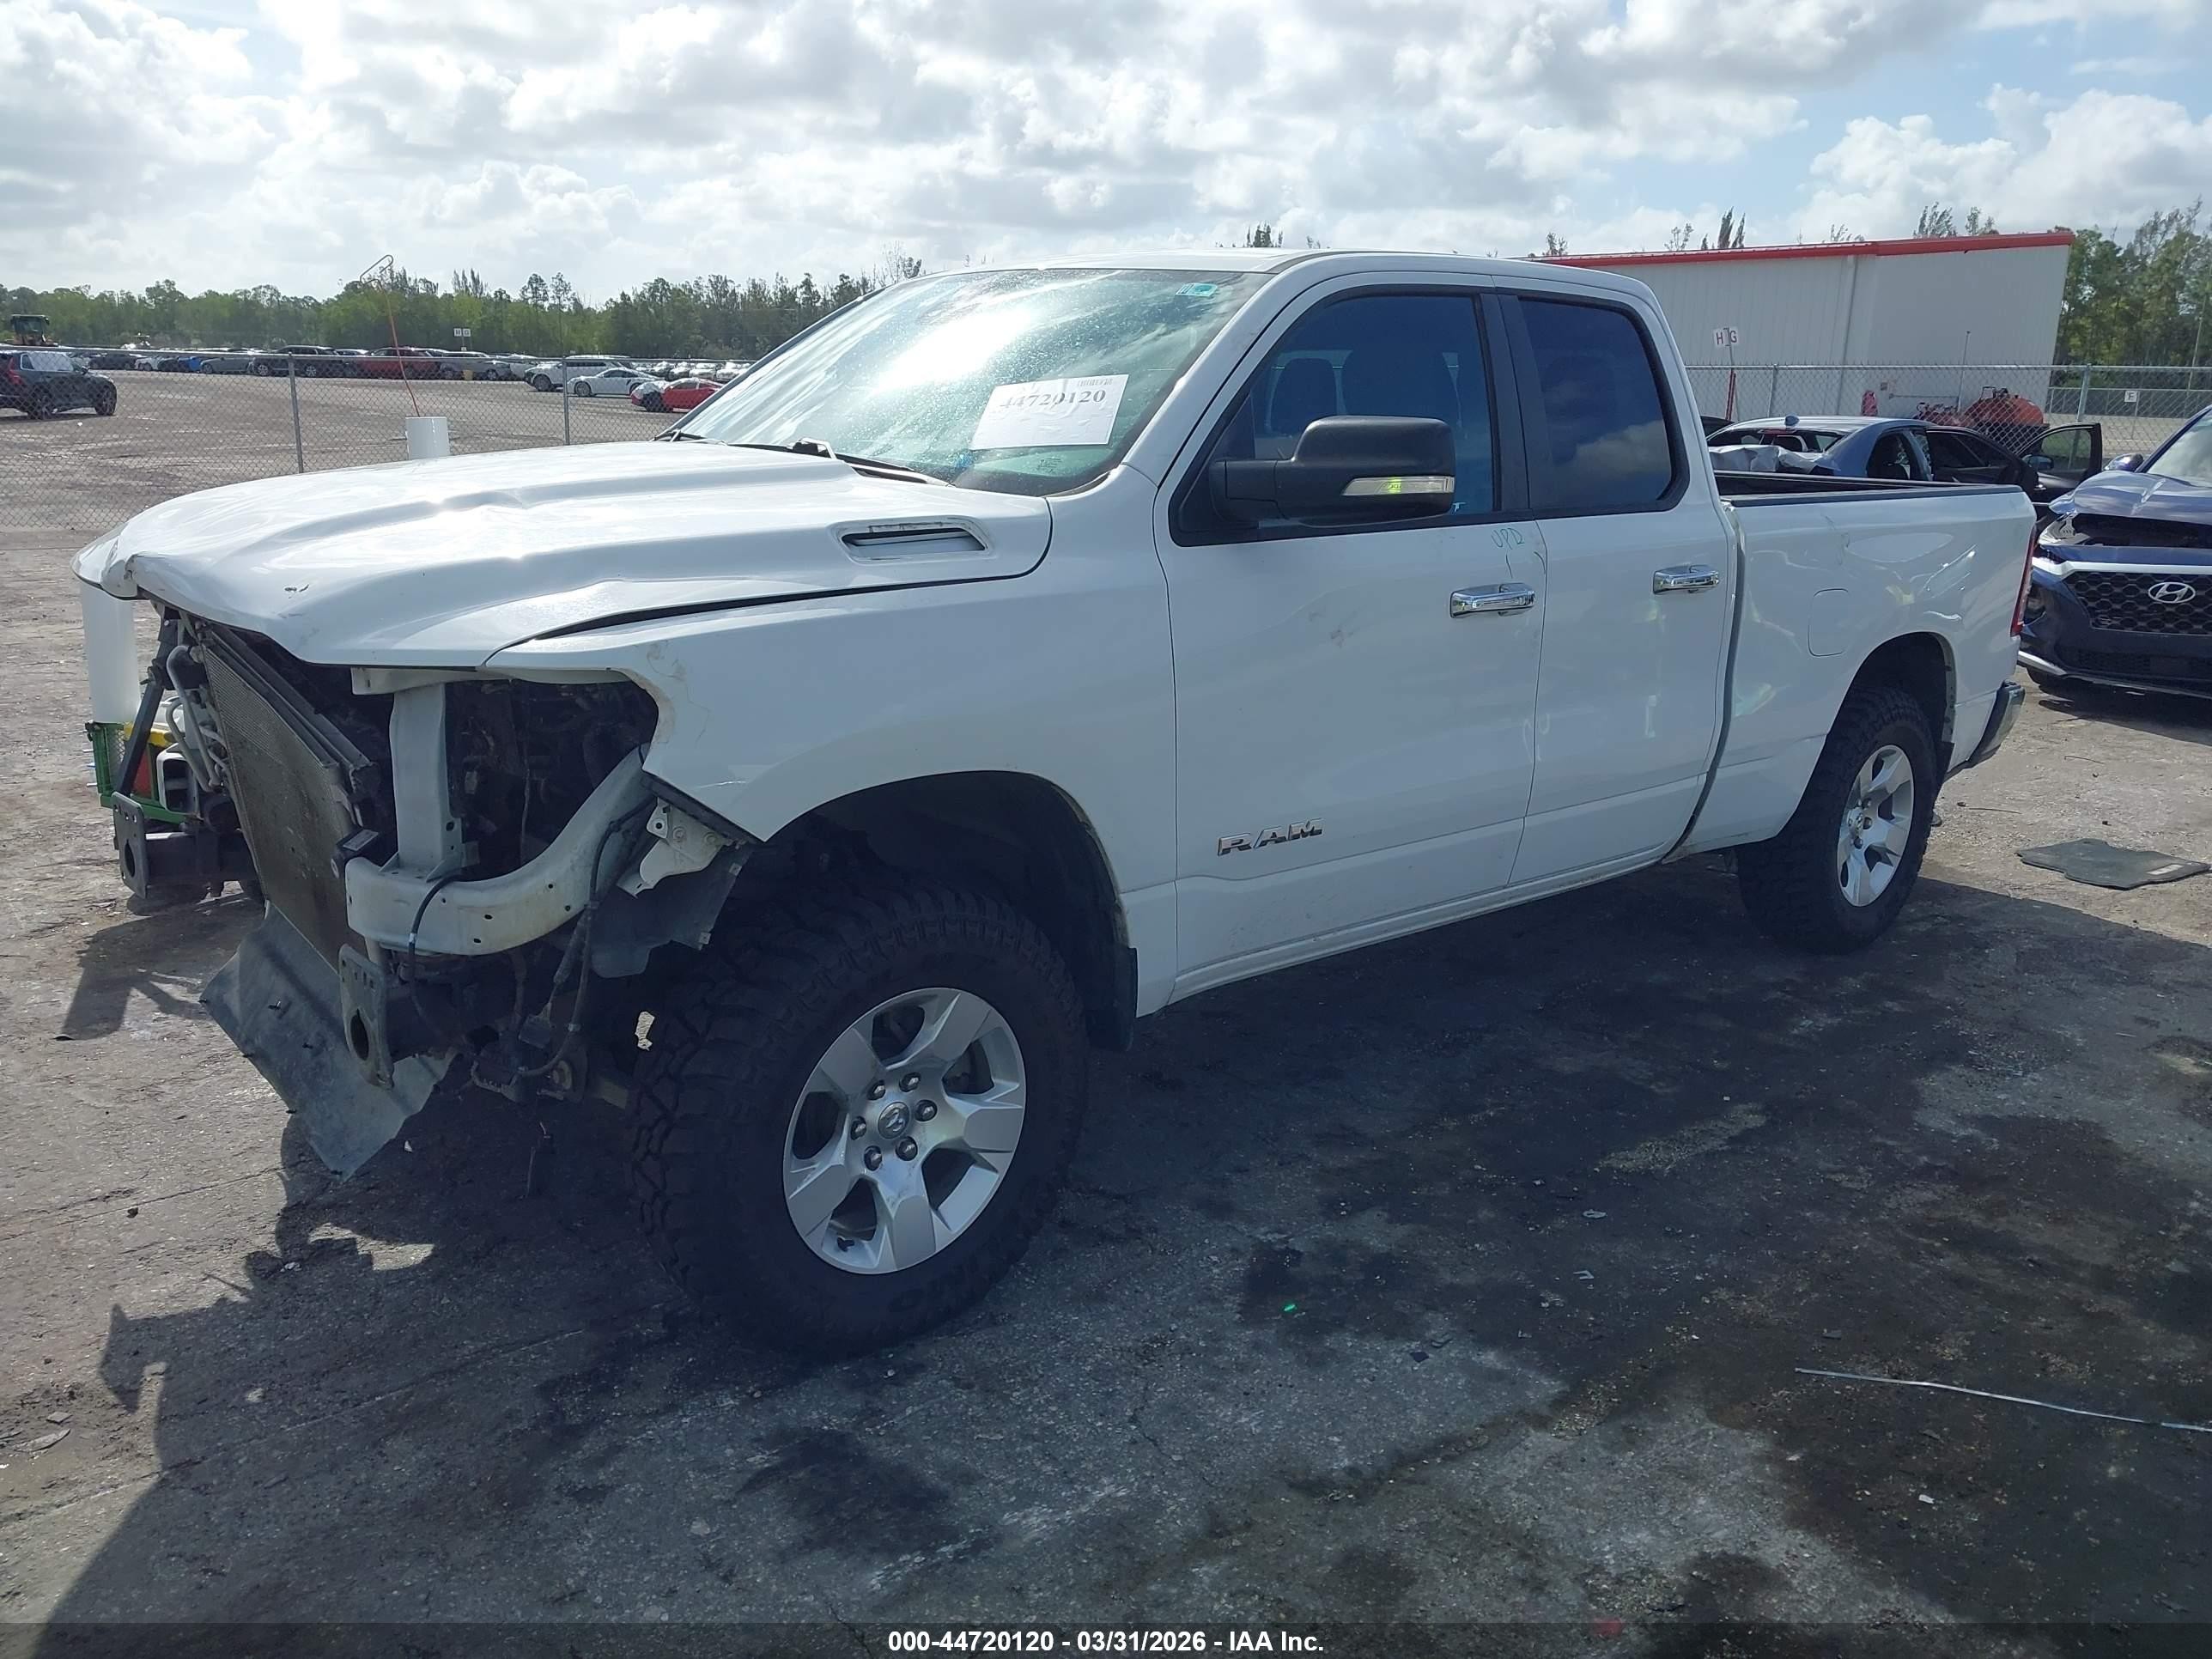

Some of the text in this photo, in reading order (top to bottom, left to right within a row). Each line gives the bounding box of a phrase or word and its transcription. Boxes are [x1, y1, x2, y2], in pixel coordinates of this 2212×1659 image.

[1716, 330, 1737, 345] H G
[1217, 817, 1323, 857] RAM
